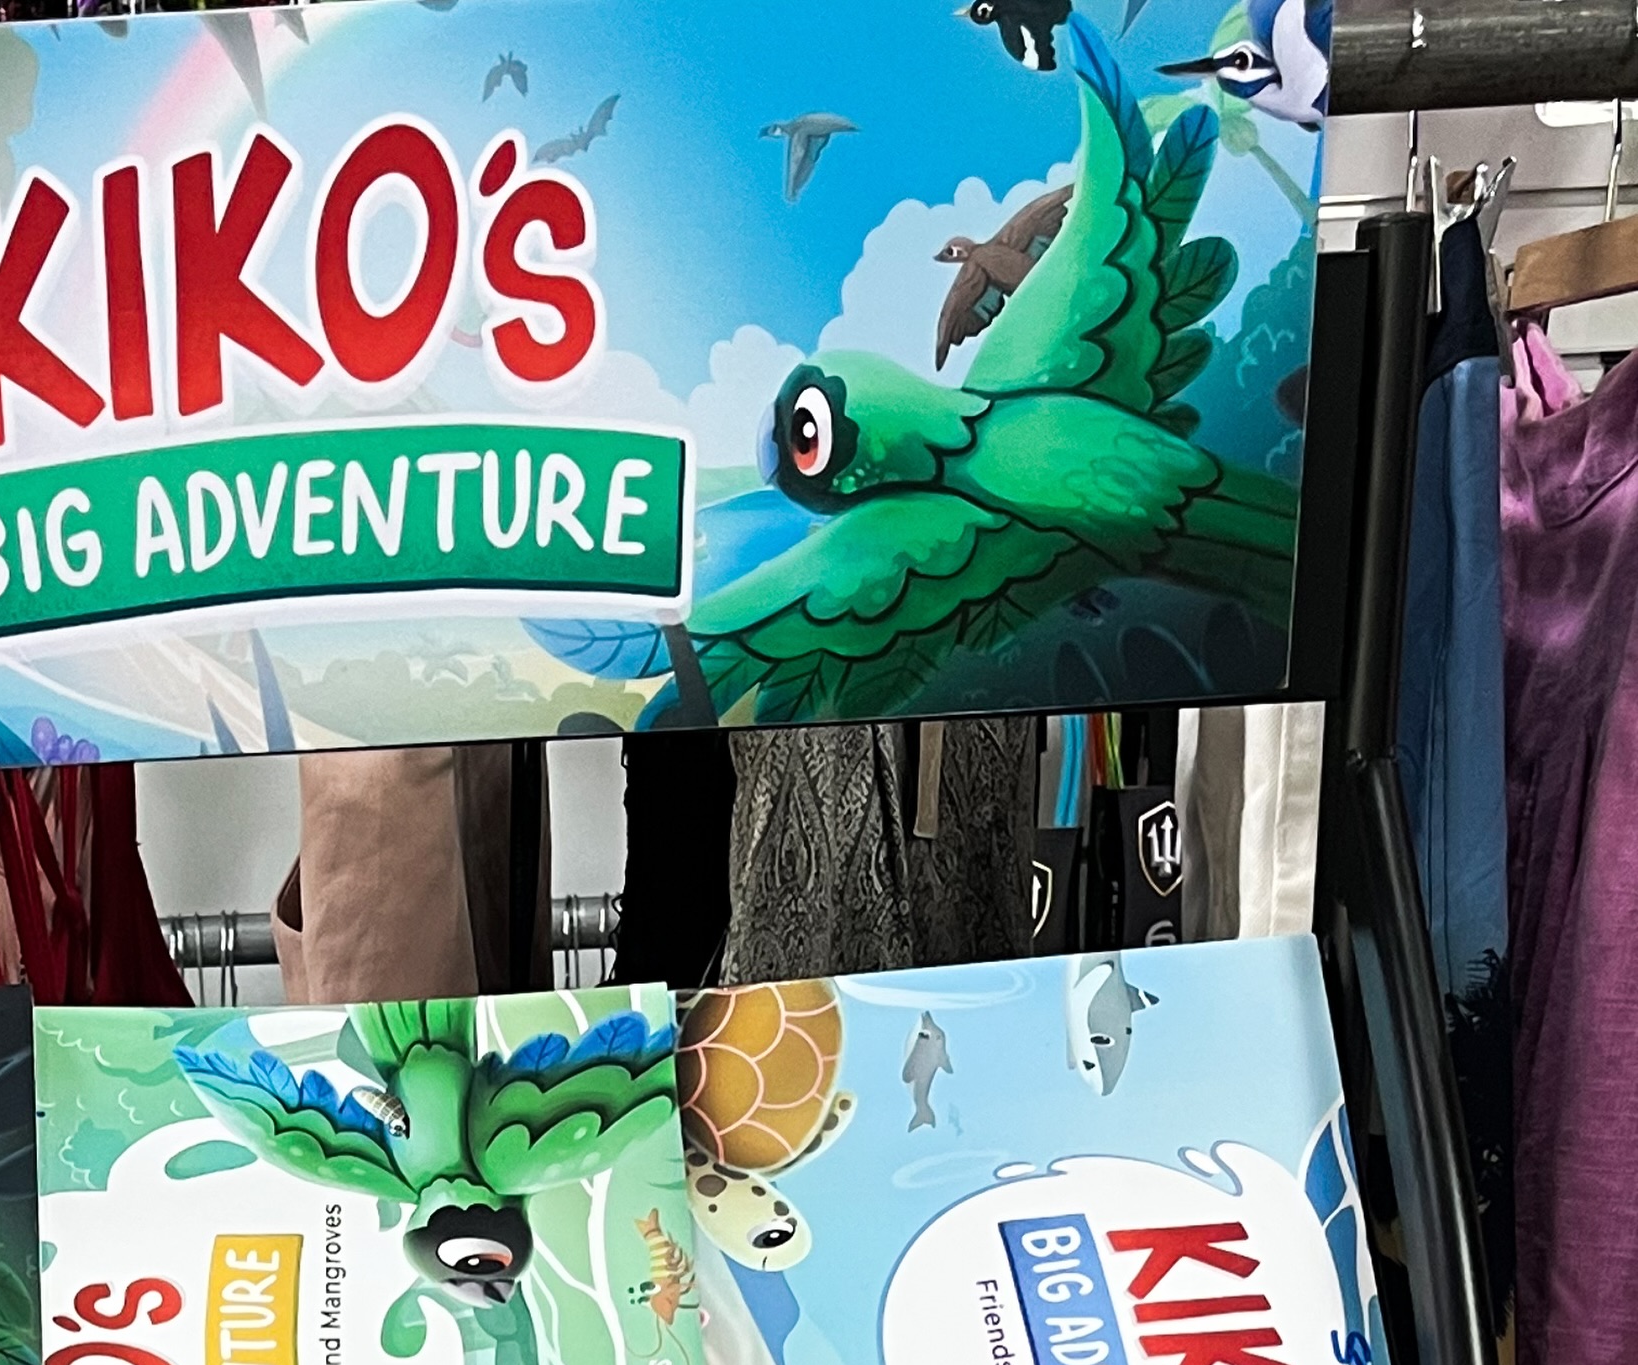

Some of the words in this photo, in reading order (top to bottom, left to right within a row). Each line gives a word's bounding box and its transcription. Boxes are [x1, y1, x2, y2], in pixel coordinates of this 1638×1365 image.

[135, 449, 653, 577] ADVENTURE
[320, 1203, 346, 1330] Mangroves
[1021, 1226, 1094, 1303] BIG
